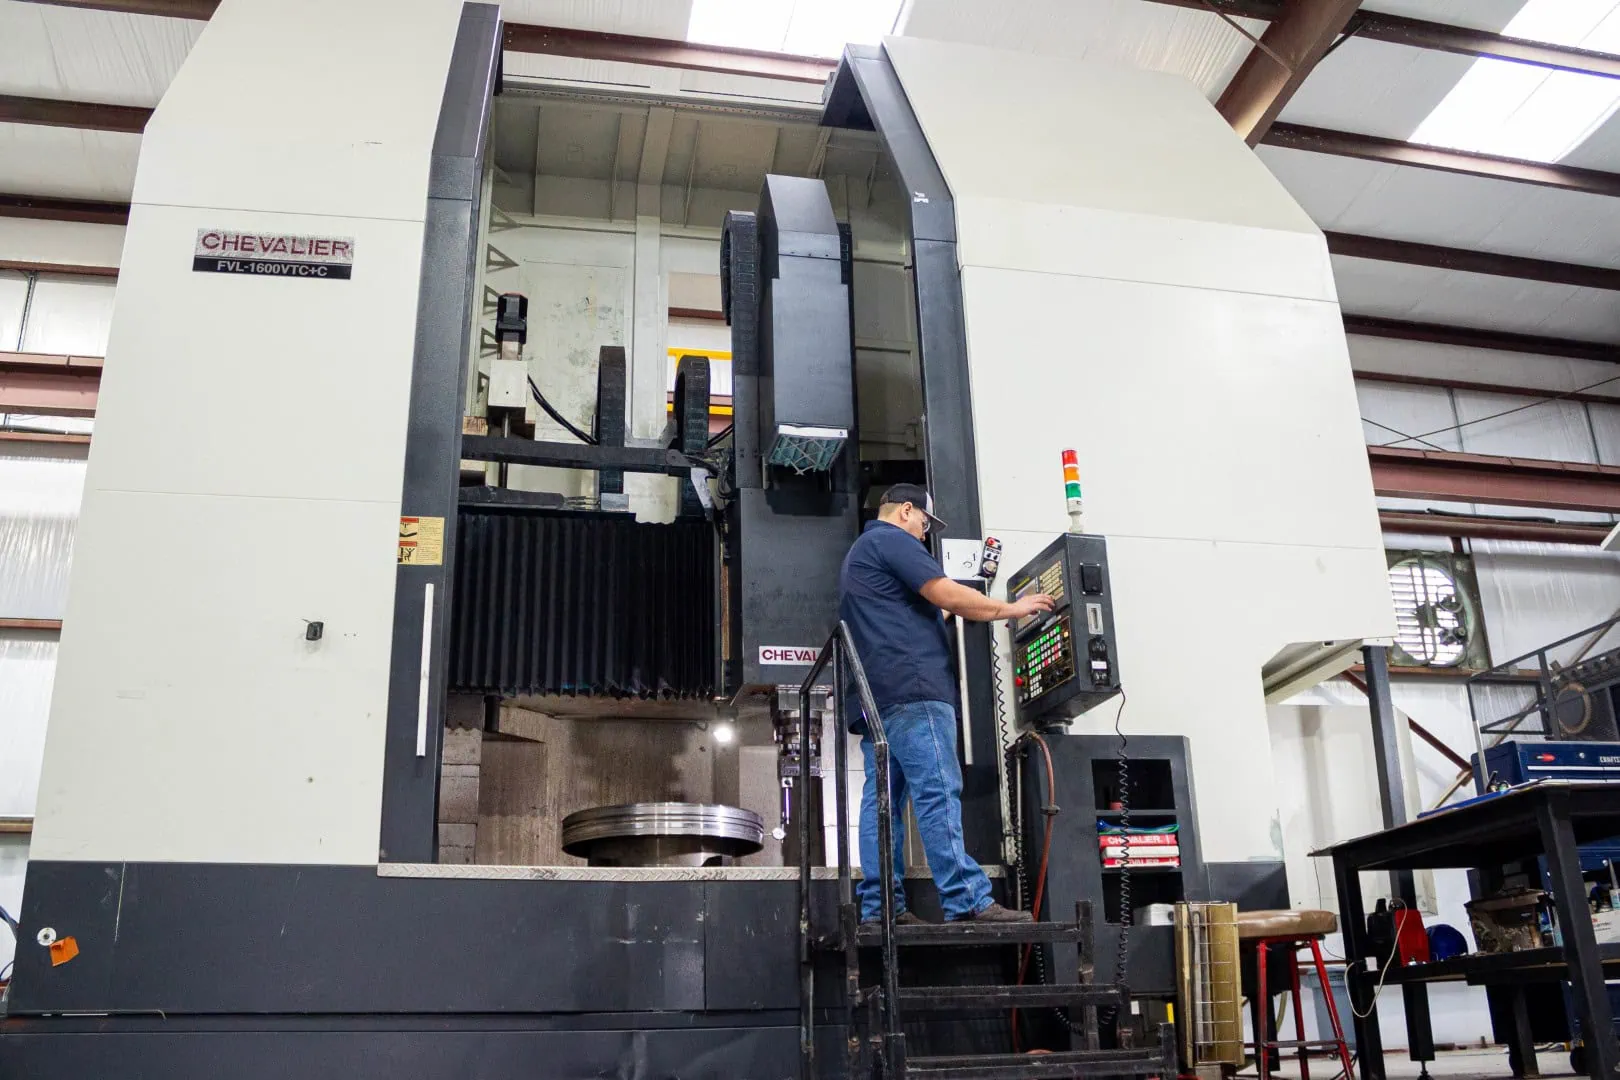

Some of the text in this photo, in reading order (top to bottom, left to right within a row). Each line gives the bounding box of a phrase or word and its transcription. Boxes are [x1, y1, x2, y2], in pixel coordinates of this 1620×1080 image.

[201, 233, 349, 256] CHEVALIER
[216, 260, 328, 277] FVL-1600VTC+C
[762, 649, 820, 662] CHEVAL
